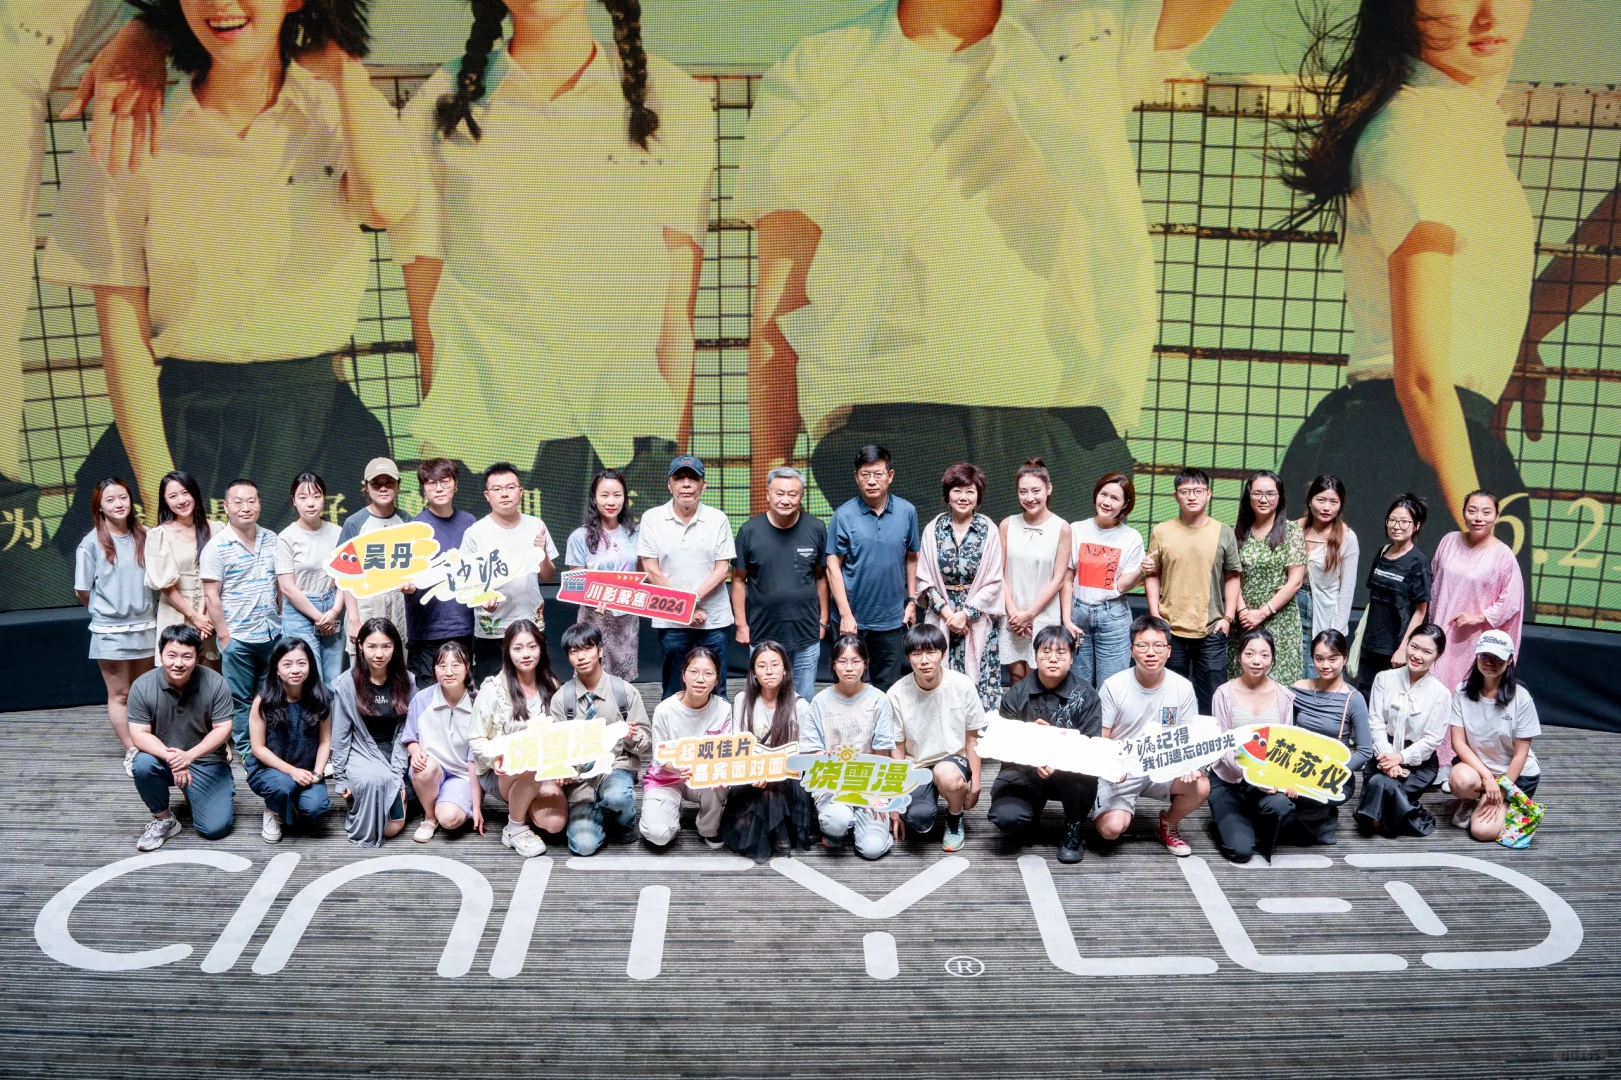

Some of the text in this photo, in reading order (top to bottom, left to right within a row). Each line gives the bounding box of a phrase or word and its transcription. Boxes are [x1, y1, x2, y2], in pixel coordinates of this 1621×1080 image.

[1492, 492, 1621, 571] 6.2
[363, 543, 413, 571] 吴丹
[444, 549, 509, 592] 沙漏
[648, 596, 686, 614] 2024
[660, 737, 751, 762] 一起观佳片
[1142, 734, 1236, 773] 我们遗忘的时光
[1266, 738, 1348, 795] 林苏仪
[693, 756, 785, 783] 嘉宾面对面
[804, 759, 909, 795] 饶雪漫
